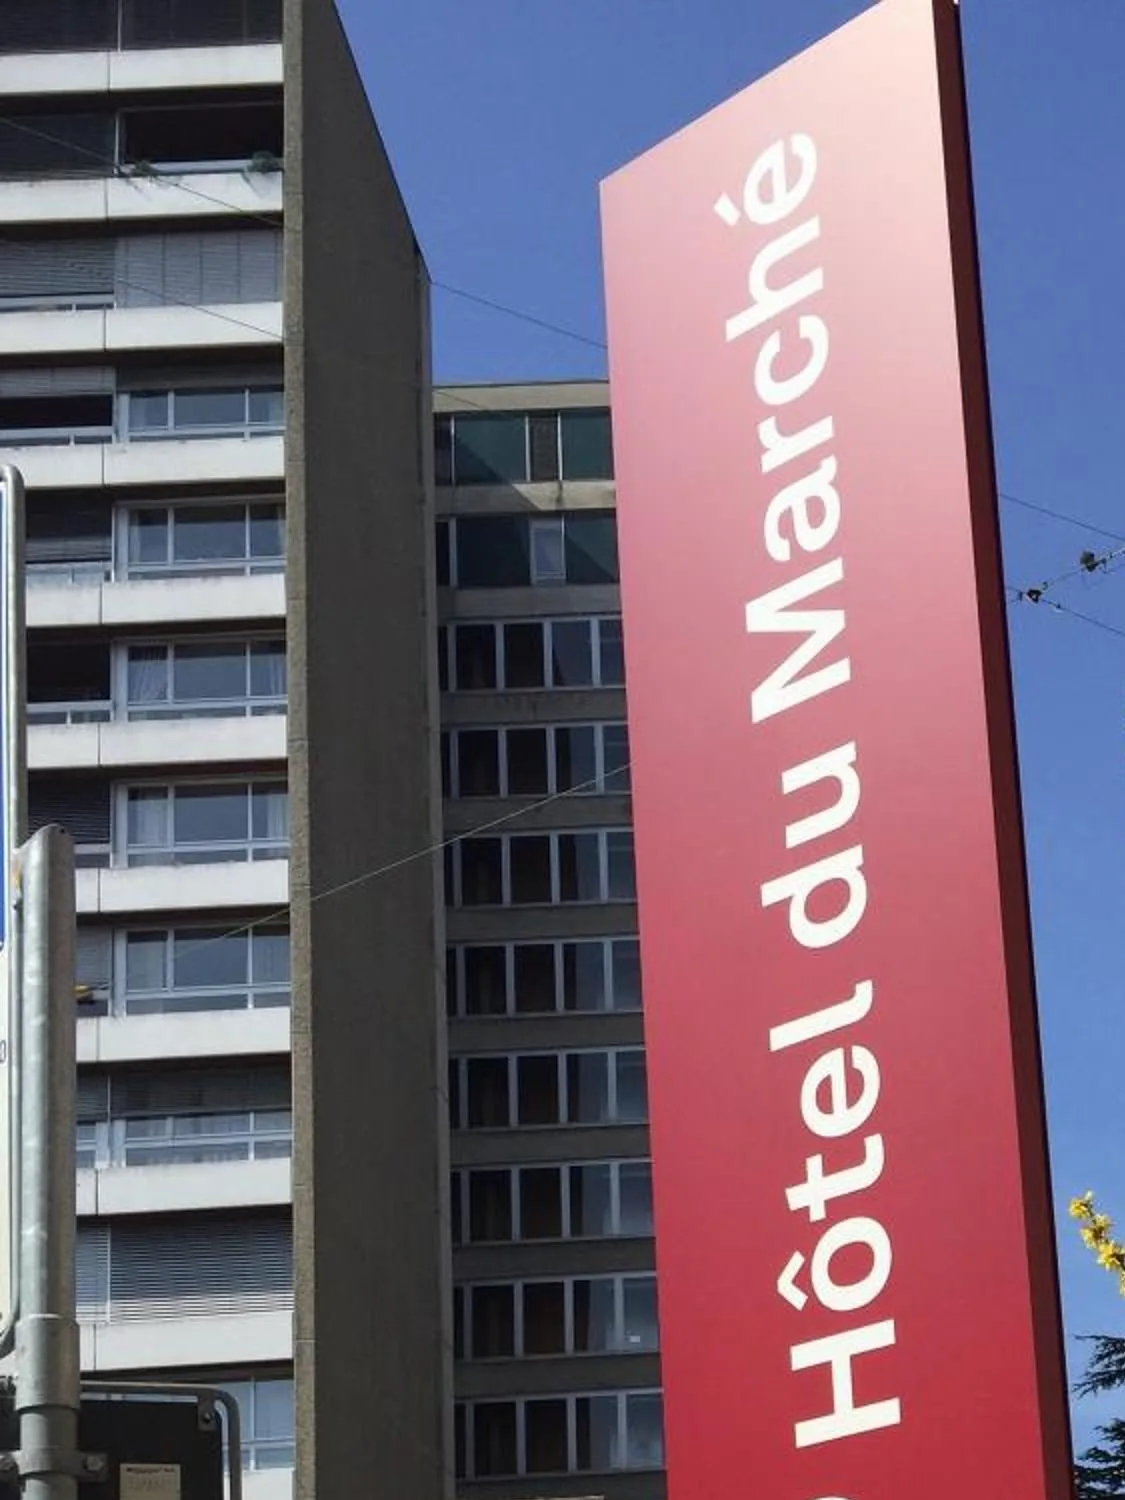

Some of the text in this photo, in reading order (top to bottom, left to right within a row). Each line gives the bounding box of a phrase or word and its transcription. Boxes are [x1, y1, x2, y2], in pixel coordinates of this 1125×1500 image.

[713, 131, 901, 1448] Hôtel du Marché
